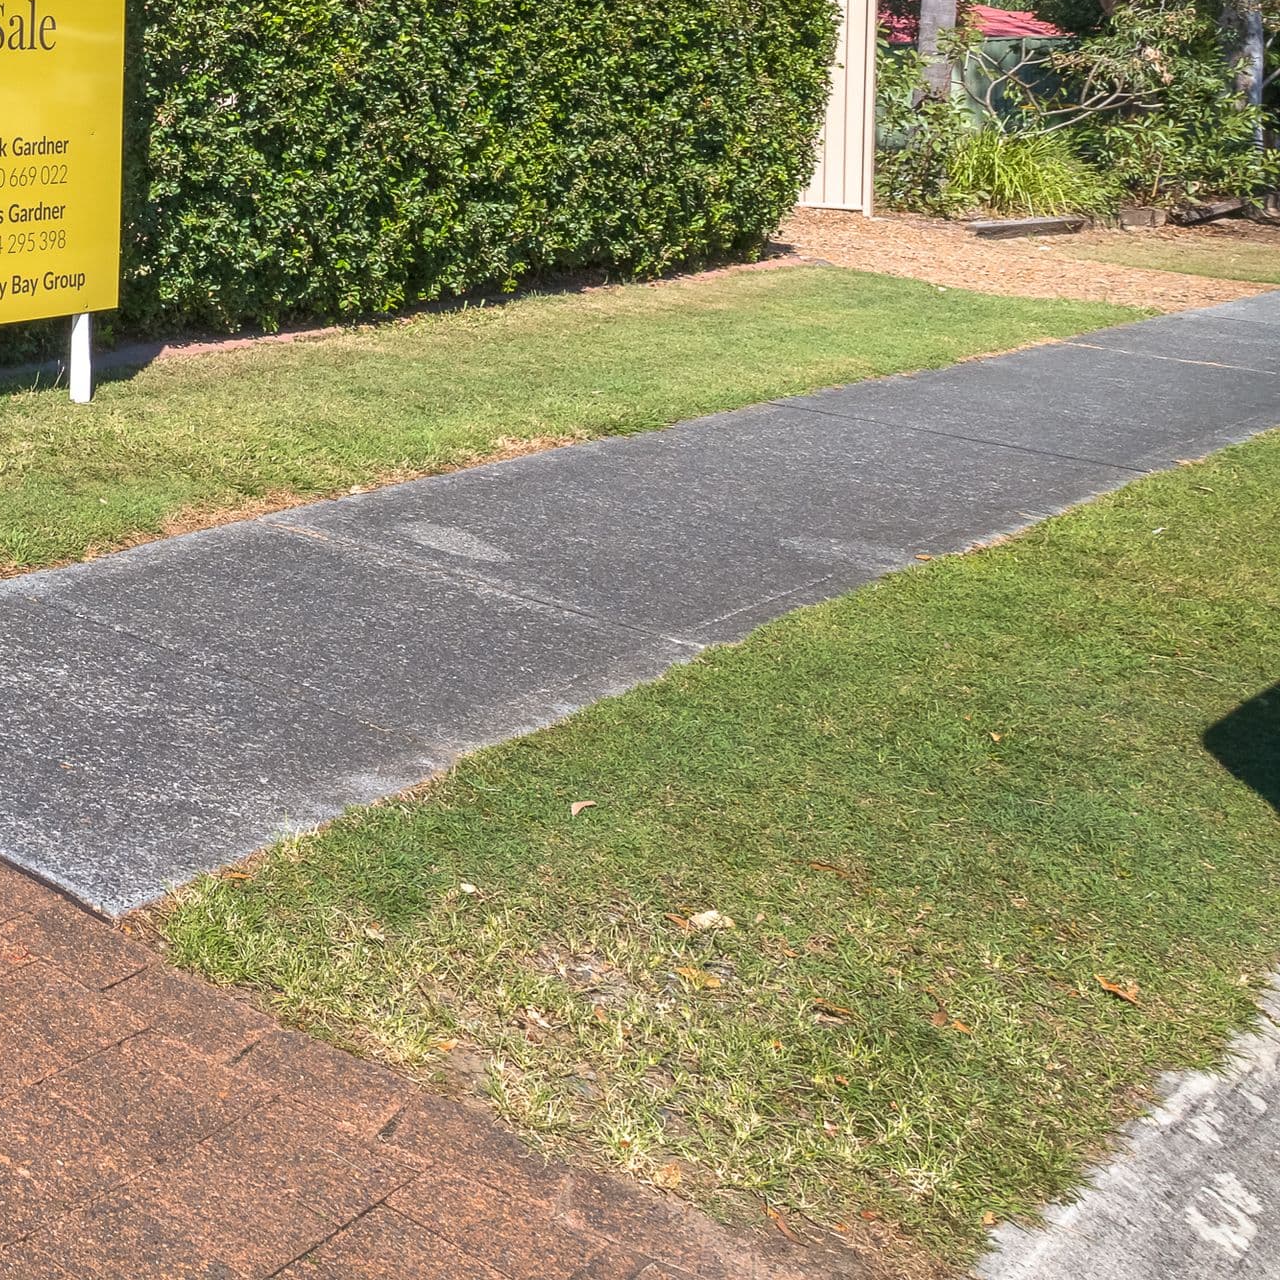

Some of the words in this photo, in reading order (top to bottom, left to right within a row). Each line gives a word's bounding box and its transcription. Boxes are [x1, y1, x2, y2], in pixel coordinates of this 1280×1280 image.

[12, 136, 69, 157] Gardner
[9, 166, 37, 187] 669
[40, 164, 68, 185] 022
[8, 202, 66, 223] Gardner
[7, 232, 35, 254] 295
[39, 229, 67, 250] 398
[11, 274, 38, 296] Bay
[43, 271, 86, 291] Group
